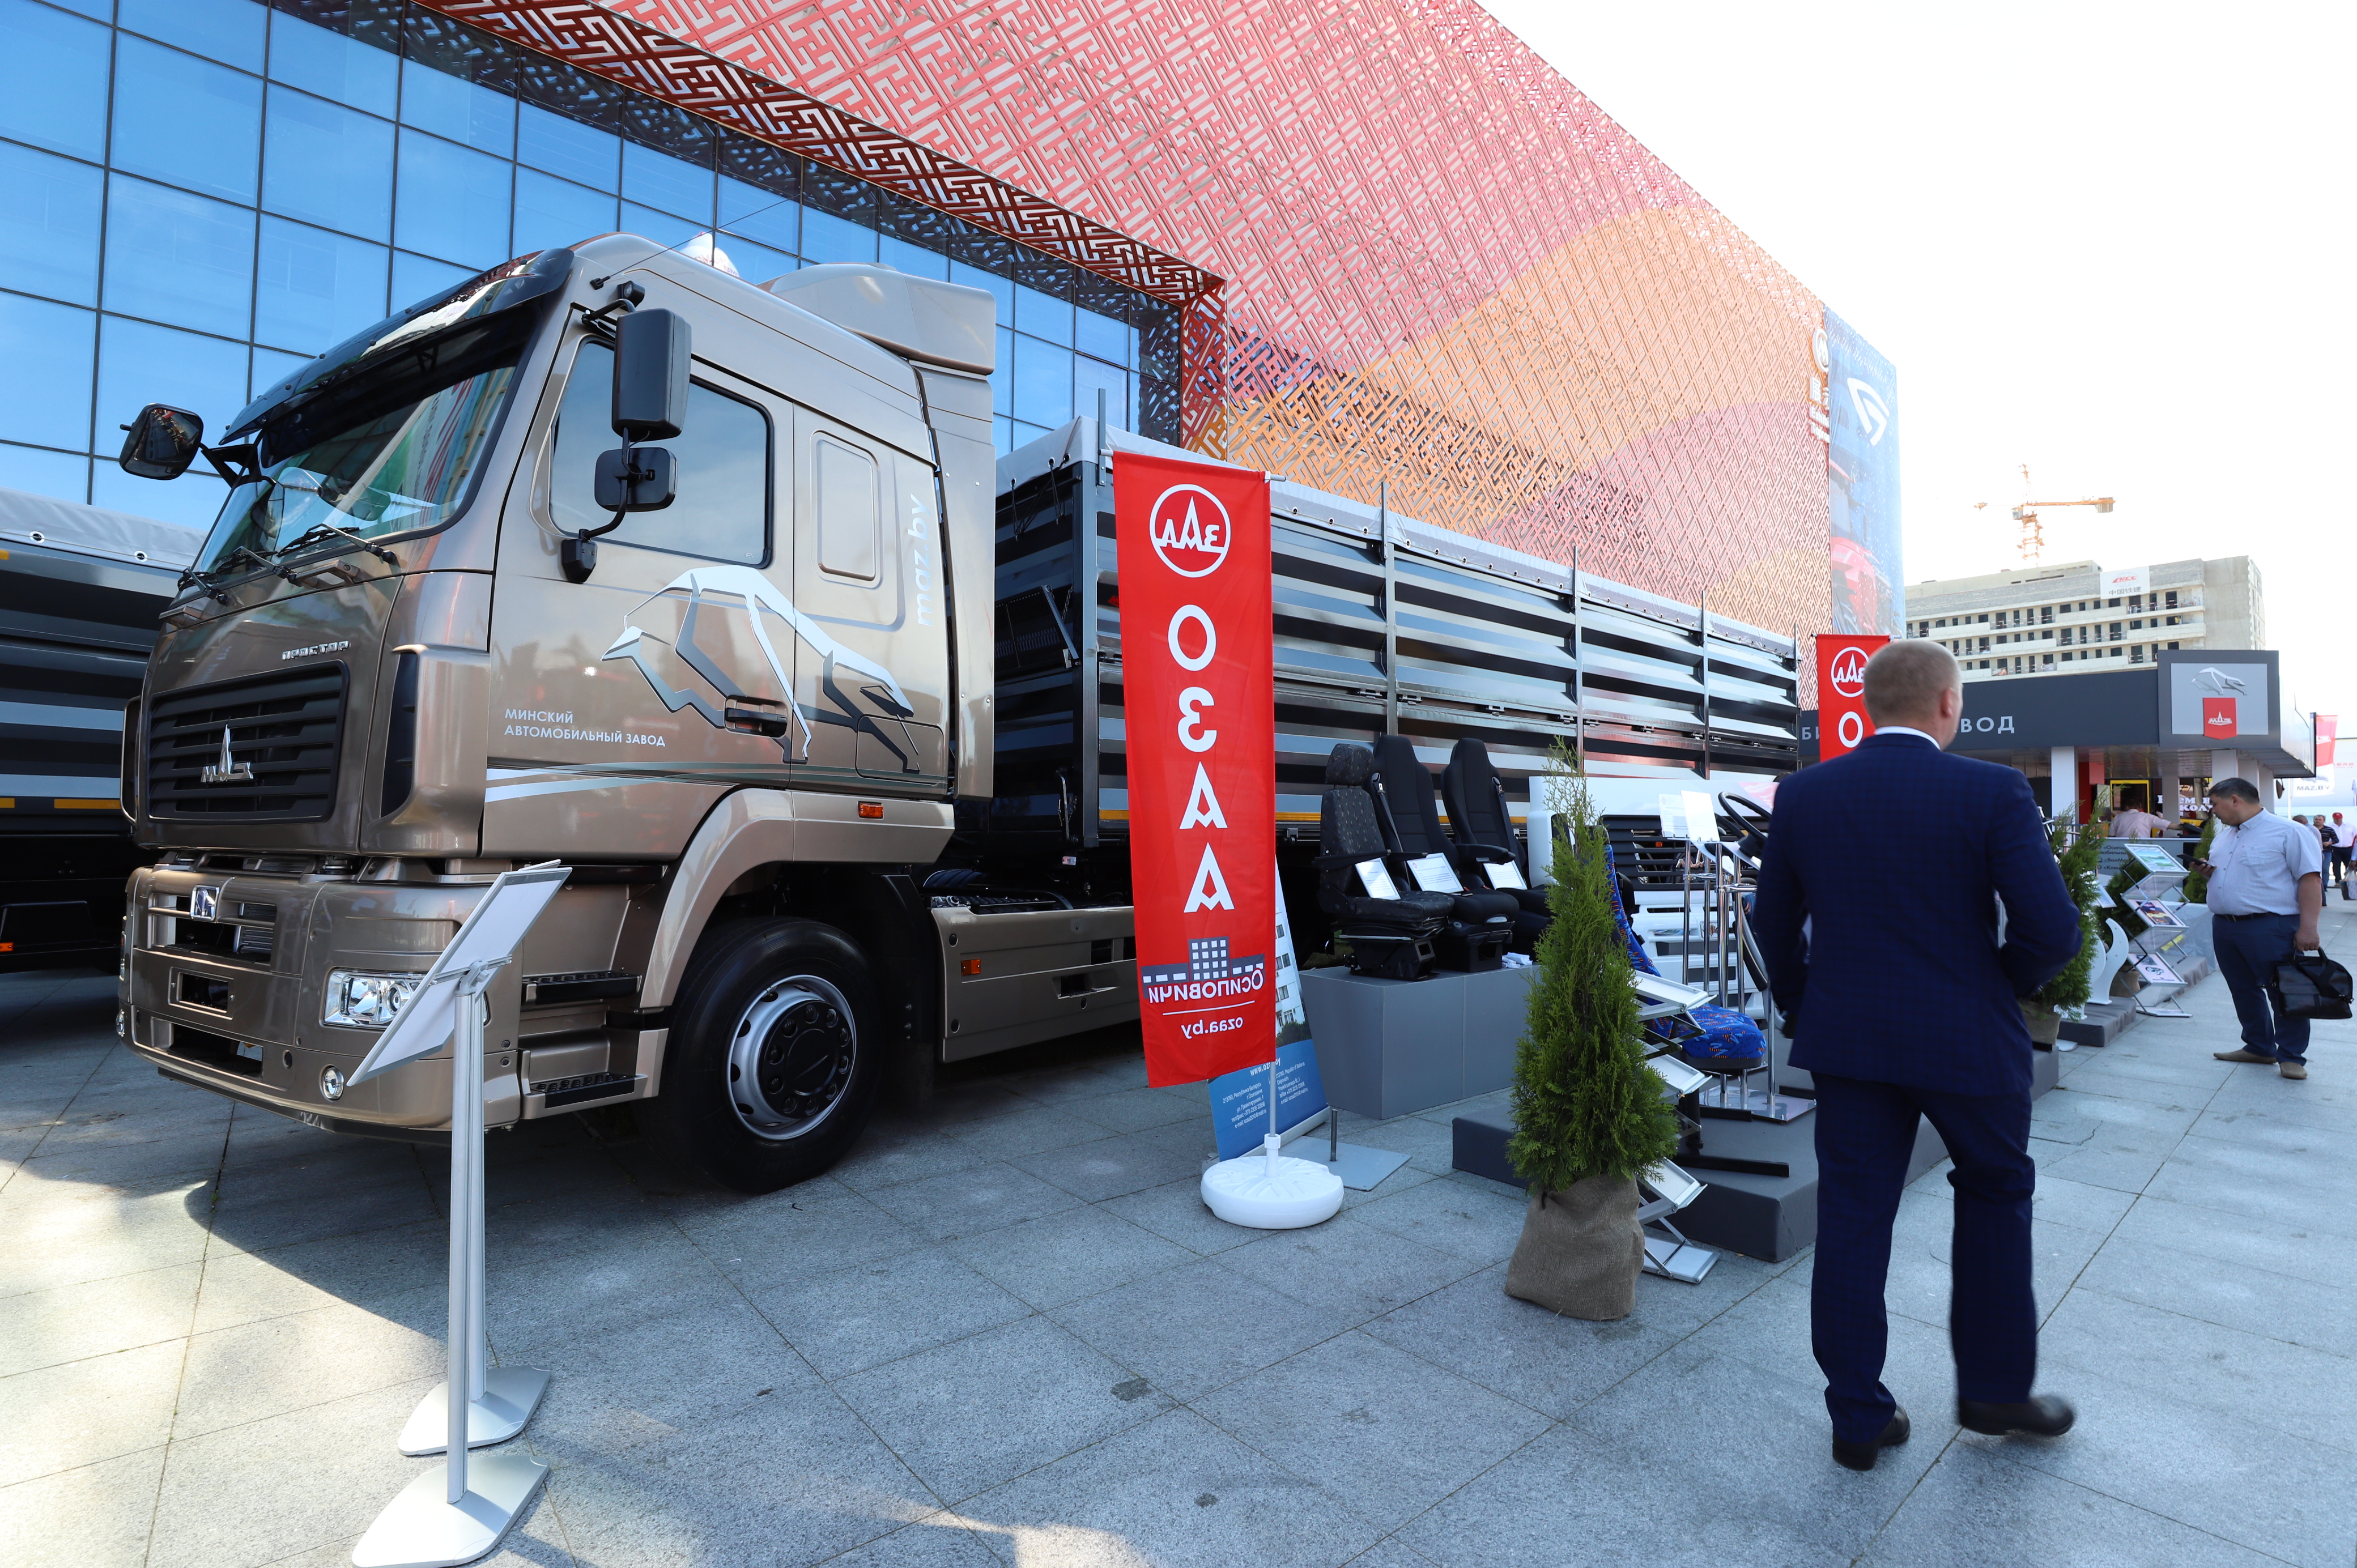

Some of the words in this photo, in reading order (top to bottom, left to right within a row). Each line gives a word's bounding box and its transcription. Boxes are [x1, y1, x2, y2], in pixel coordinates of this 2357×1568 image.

[1810, 406, 1830, 428] Exhibi
[908, 493, 933, 627] maz.by
[2108, 586, 2141, 596] 中国铁建
[282, 640, 351, 660] ПРОСТОР
[504, 708, 573, 724] МИНСКИЙ
[1960, 715, 2015, 734] ВОД
[504, 725, 622, 743] АВТОМОБИЛЬНЫЙ
[625, 733, 665, 747] ЗАВОД
[1233, 1088, 1250, 1098] Республика
